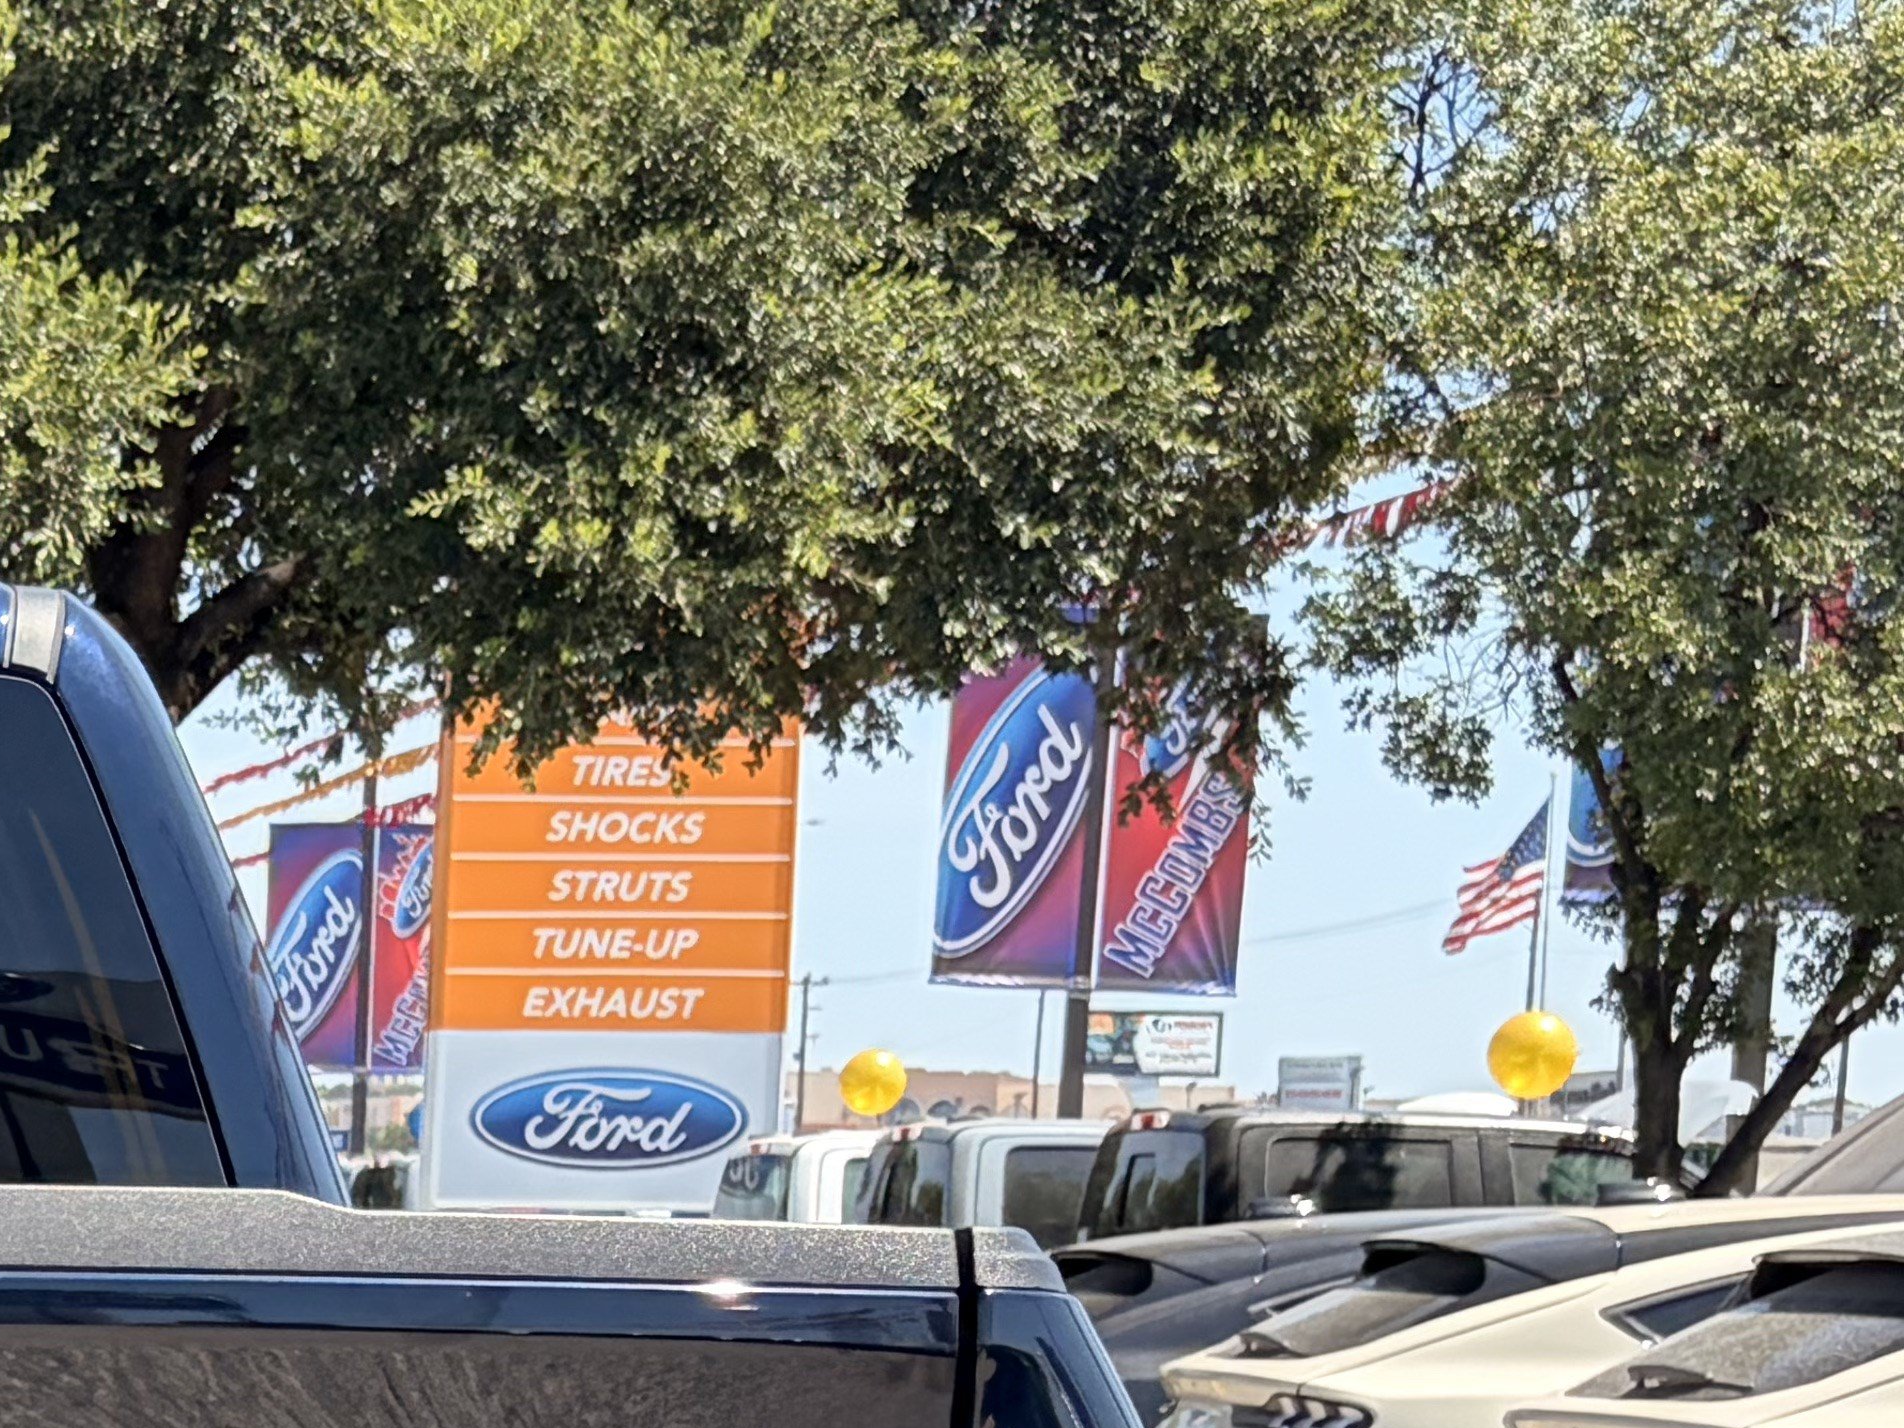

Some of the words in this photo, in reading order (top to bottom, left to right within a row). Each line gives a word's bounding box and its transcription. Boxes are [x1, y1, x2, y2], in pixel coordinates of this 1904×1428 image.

[572, 754, 674, 788] TIRES
[948, 704, 1083, 908] Ford
[545, 810, 707, 844] SHOCKS
[547, 869, 693, 903] STRUTS
[272, 884, 356, 1022] Ford
[532, 927, 700, 960] TUNE-UP
[522, 986, 705, 1020] EXHAUST
[523, 1083, 693, 1154] Ford
